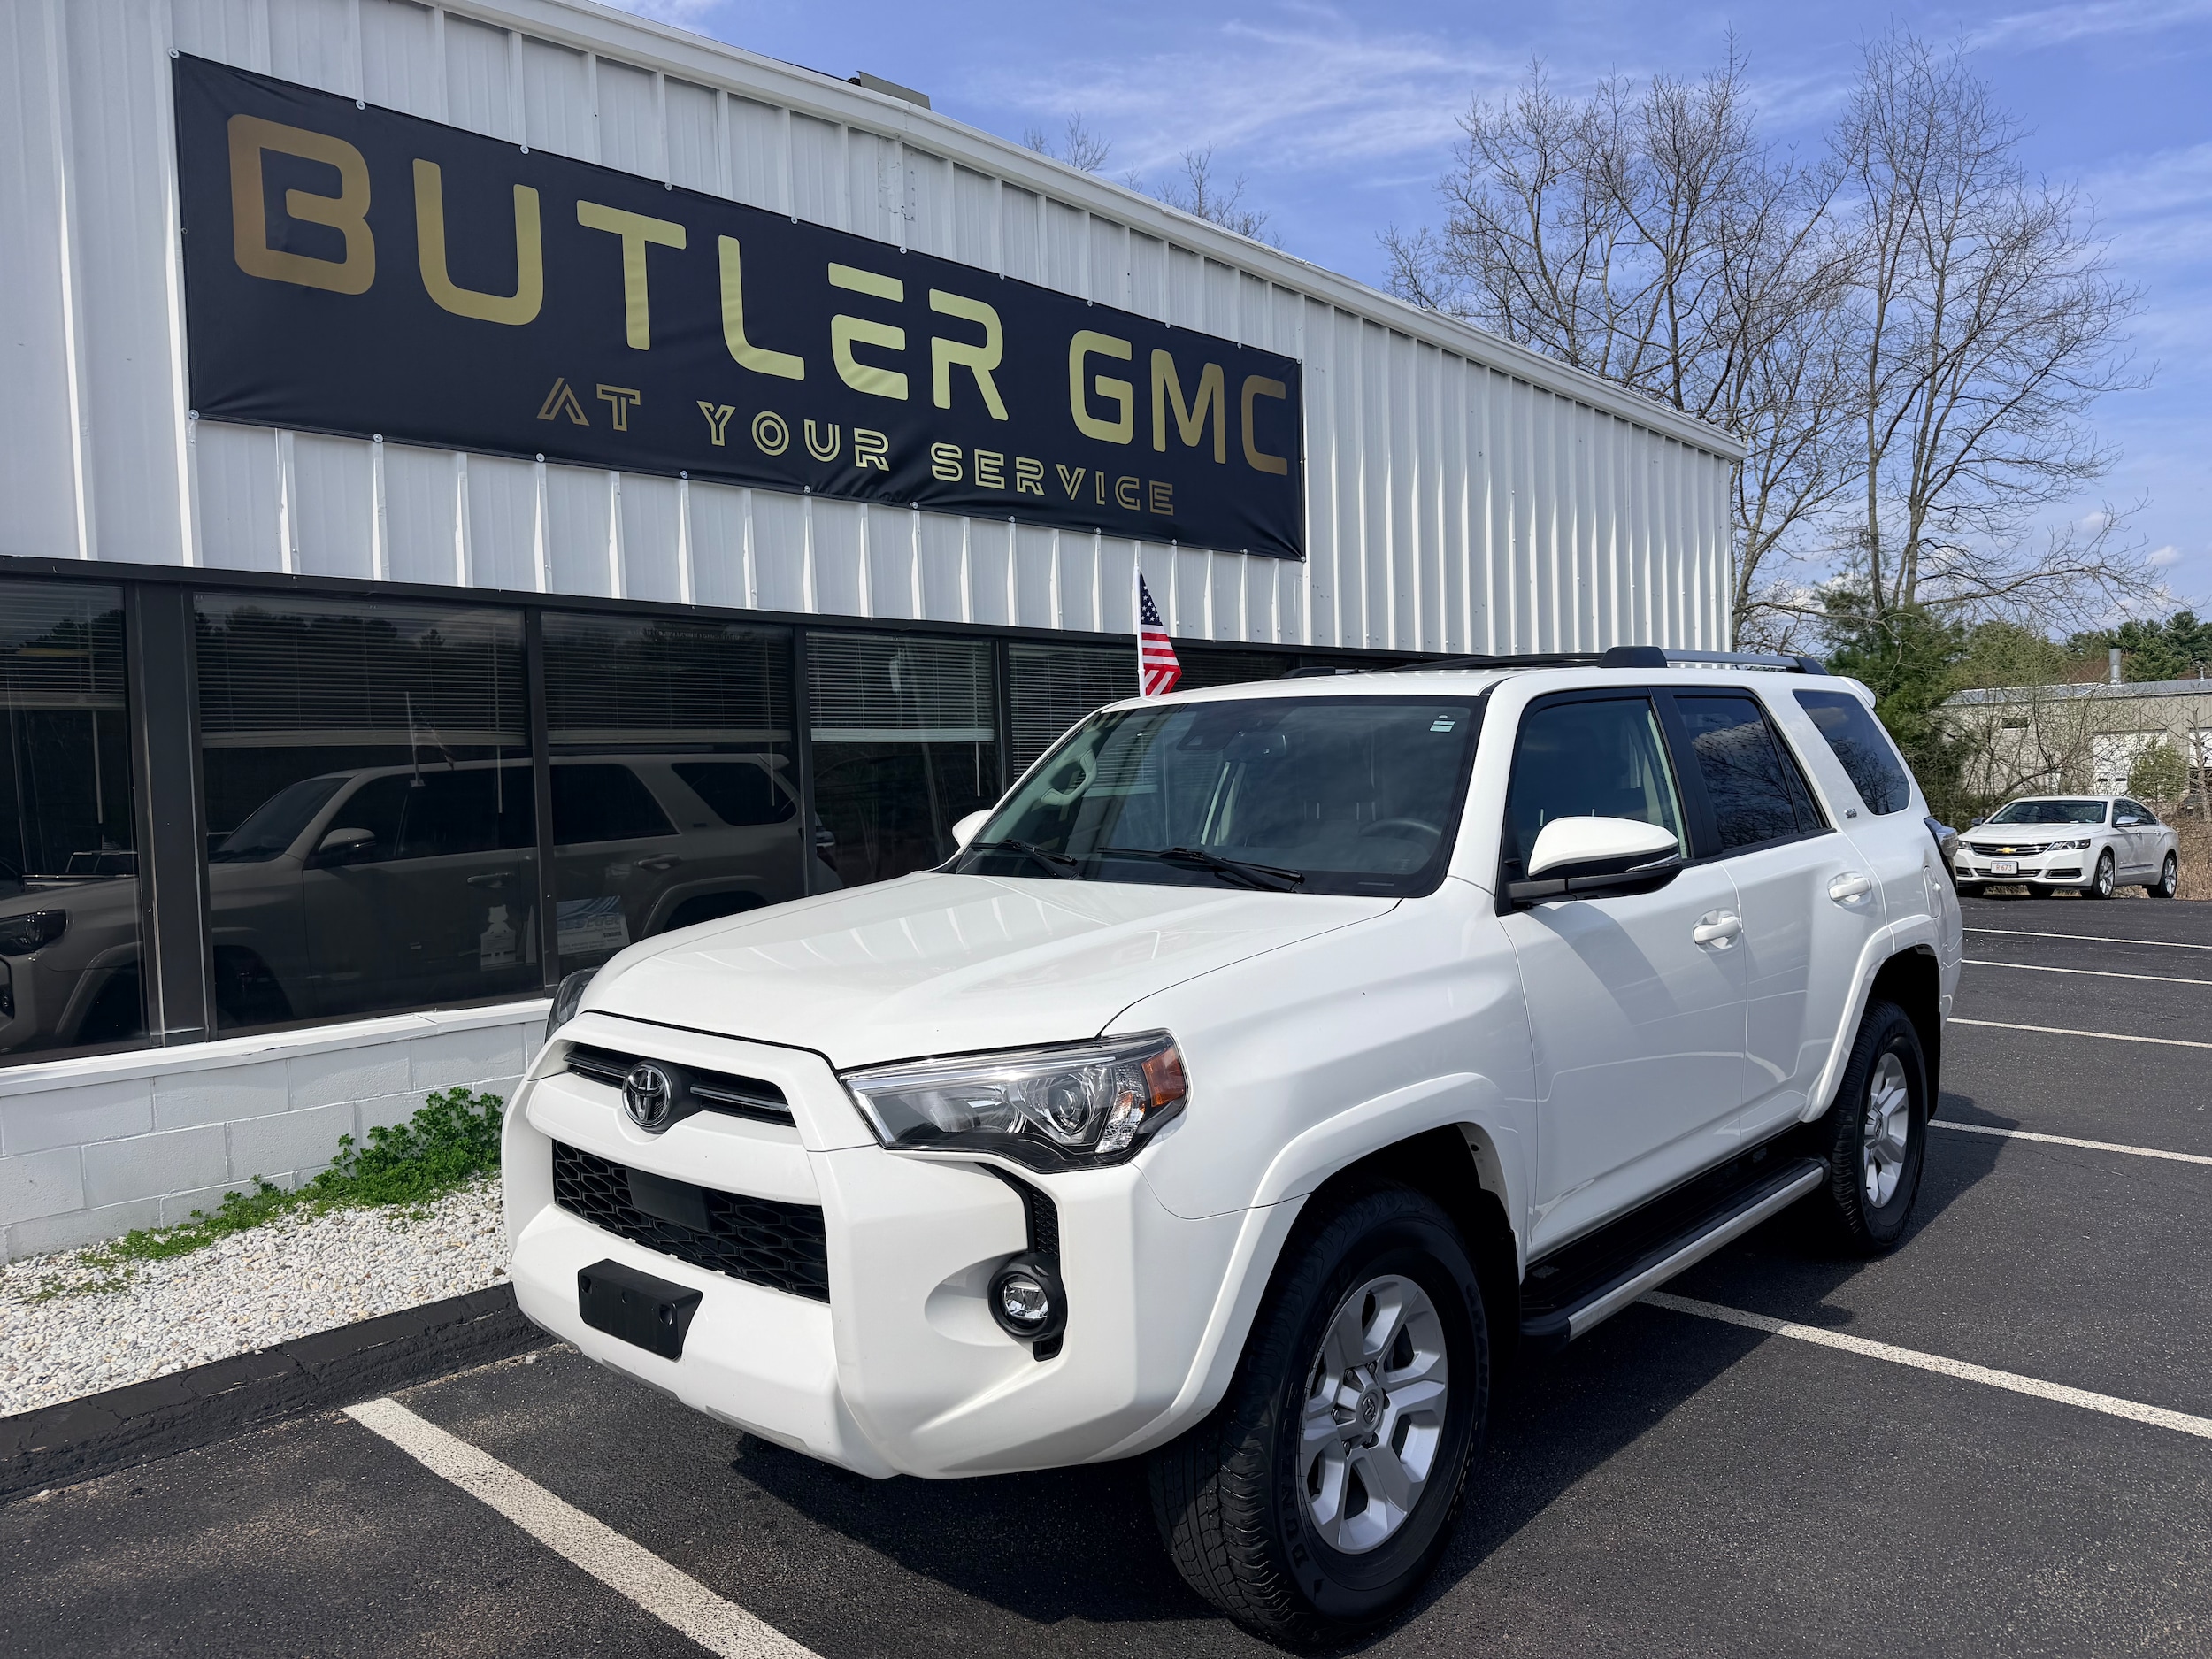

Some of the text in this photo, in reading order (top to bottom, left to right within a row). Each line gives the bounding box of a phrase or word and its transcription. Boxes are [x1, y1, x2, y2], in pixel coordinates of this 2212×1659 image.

[227, 113, 1288, 476] BUTLER GMC
[536, 377, 1175, 516] AT YOUR SERVICE
